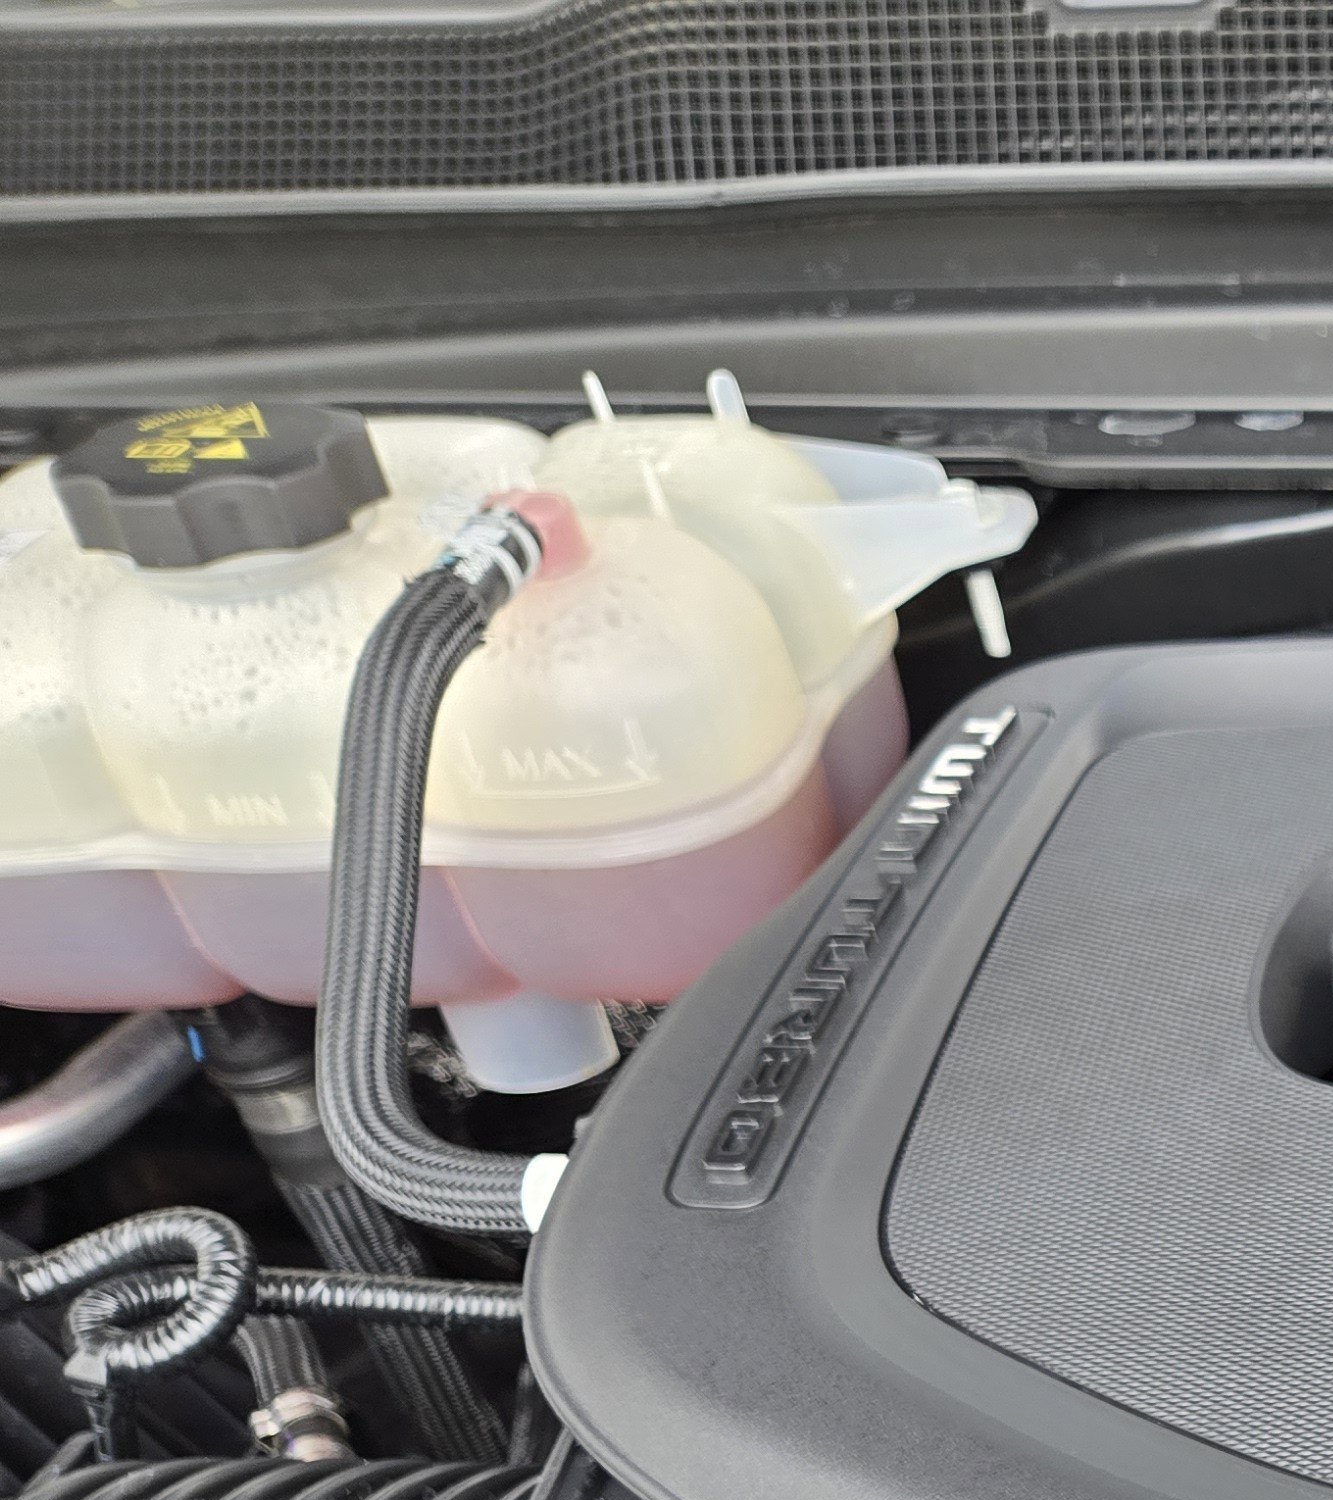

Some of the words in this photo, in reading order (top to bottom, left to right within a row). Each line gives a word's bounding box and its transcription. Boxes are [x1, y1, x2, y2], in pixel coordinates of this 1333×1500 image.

[205, 793, 289, 827] MIN
[501, 746, 602, 781] MAX
[873, 705, 1017, 874] TWIN
[702, 878, 899, 1180] TURBO
